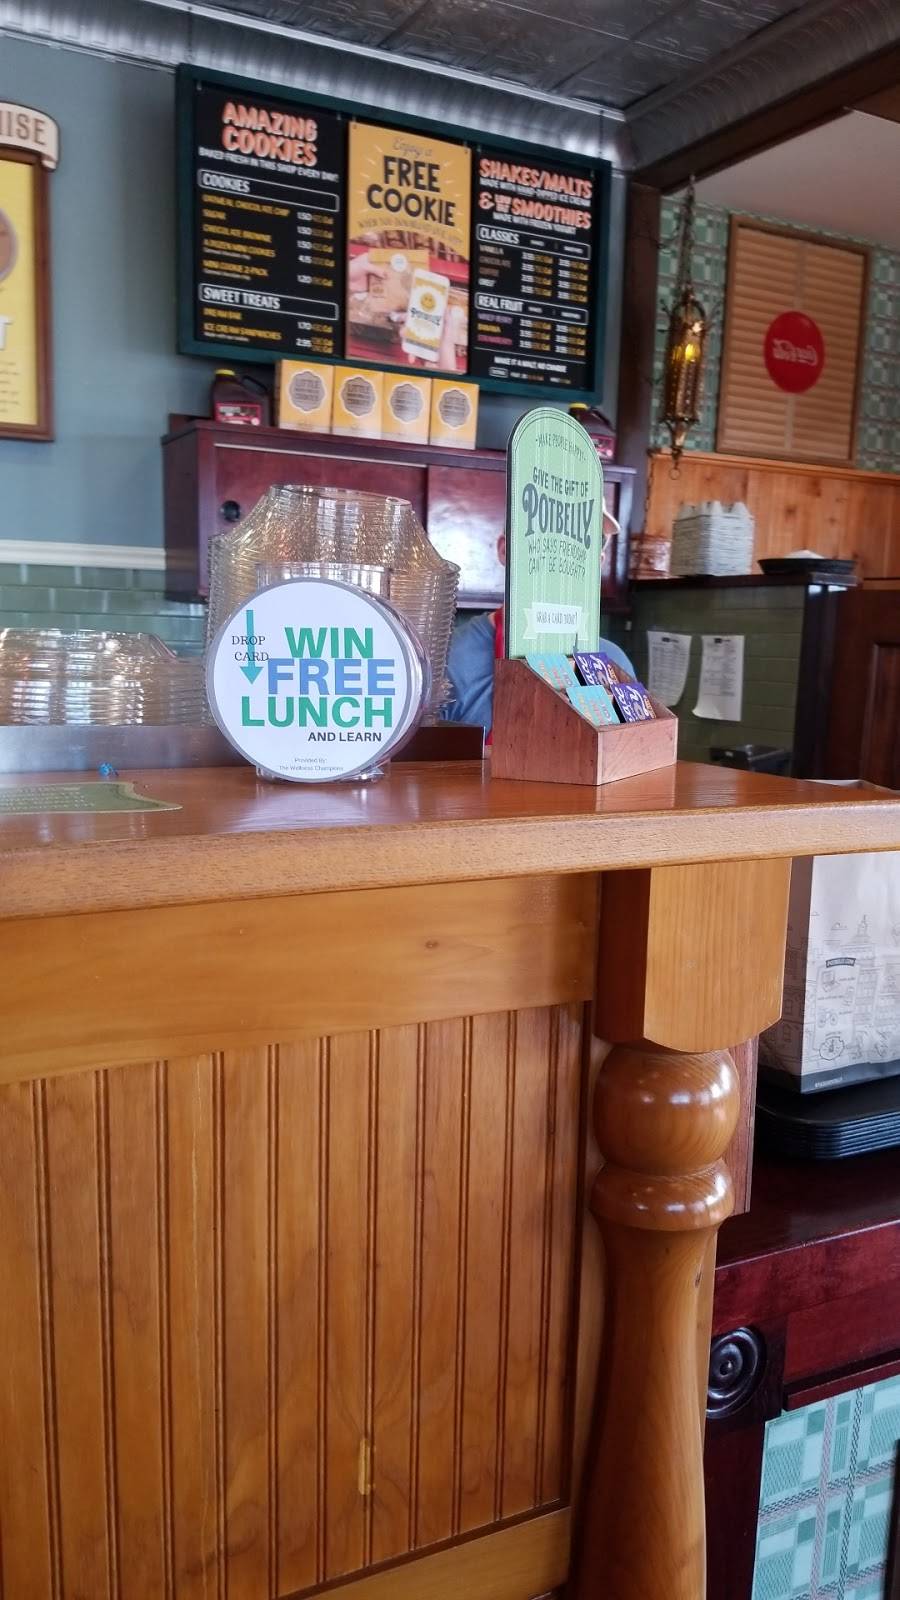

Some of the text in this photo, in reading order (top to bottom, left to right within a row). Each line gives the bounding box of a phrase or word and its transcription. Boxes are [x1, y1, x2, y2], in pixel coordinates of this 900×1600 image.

[0, 110, 46, 145] ISE
[222, 101, 318, 142] AMAZING
[222, 125, 318, 167] COOKIES
[202, 173, 251, 193] COOKIES
[383, 155, 441, 193] FREE
[479, 158, 592, 200] SHAKES/MALTS
[367, 183, 456, 227] COOKIE
[479, 191, 495, 210] &
[511, 197, 592, 230] SMOOTHIES
[480, 227, 519, 245] CLASSICS
[203, 286, 281, 310] SWEET TREATS
[478, 295, 500, 310] REAL
[500, 298, 524, 313] FRUIT
[532, 466, 589, 497] GIVE THE GIFT OF
[522, 482, 595, 550] POTBELLY
[528, 537, 541, 555] WHO
[542, 537, 557, 554] SAYS
[231, 635, 266, 646] DROP
[234, 651, 269, 662] CARD
[284, 627, 374, 659] WIN
[267, 658, 396, 696] FREE
[241, 696, 393, 728] LUNCH
[307, 732, 382, 742] AND LEARN
